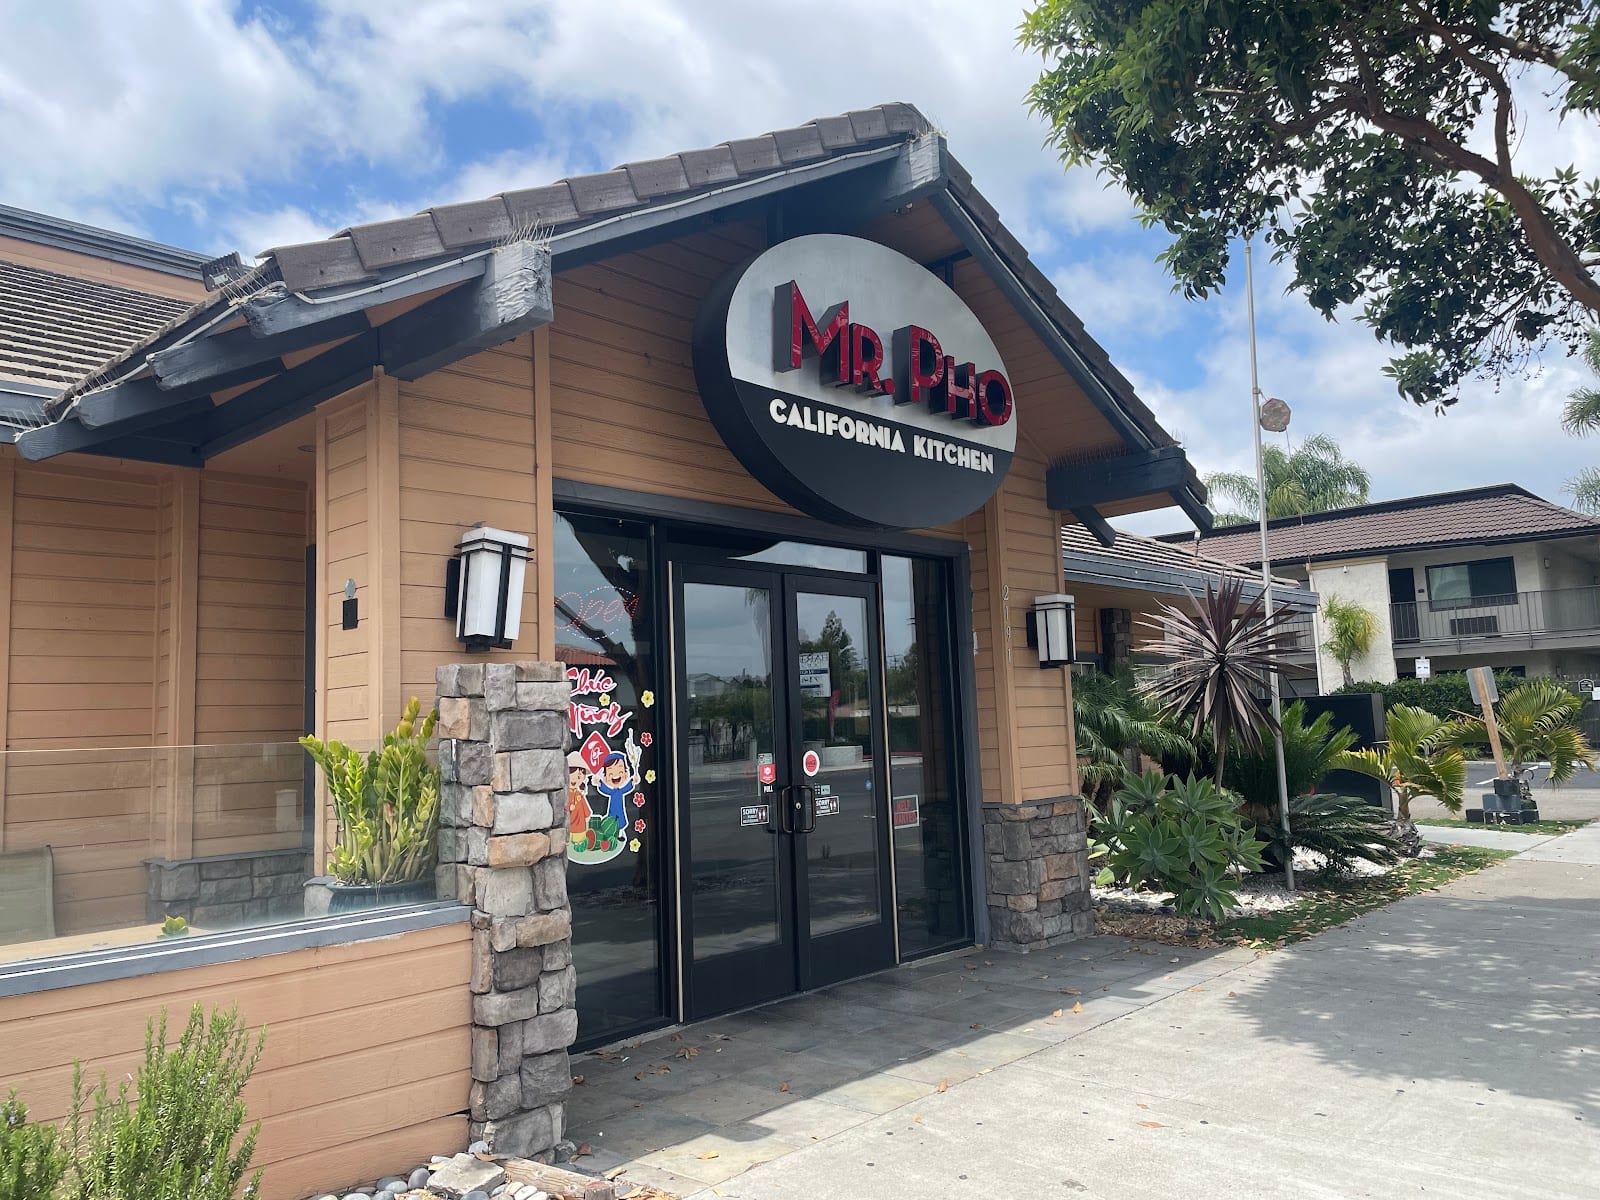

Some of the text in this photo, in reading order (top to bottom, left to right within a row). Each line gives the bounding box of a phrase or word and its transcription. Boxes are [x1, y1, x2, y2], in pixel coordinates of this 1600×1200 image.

[774, 279, 1012, 427] MR. PHO
[769, 398, 994, 474] CALIFORNIA KITCHEN
